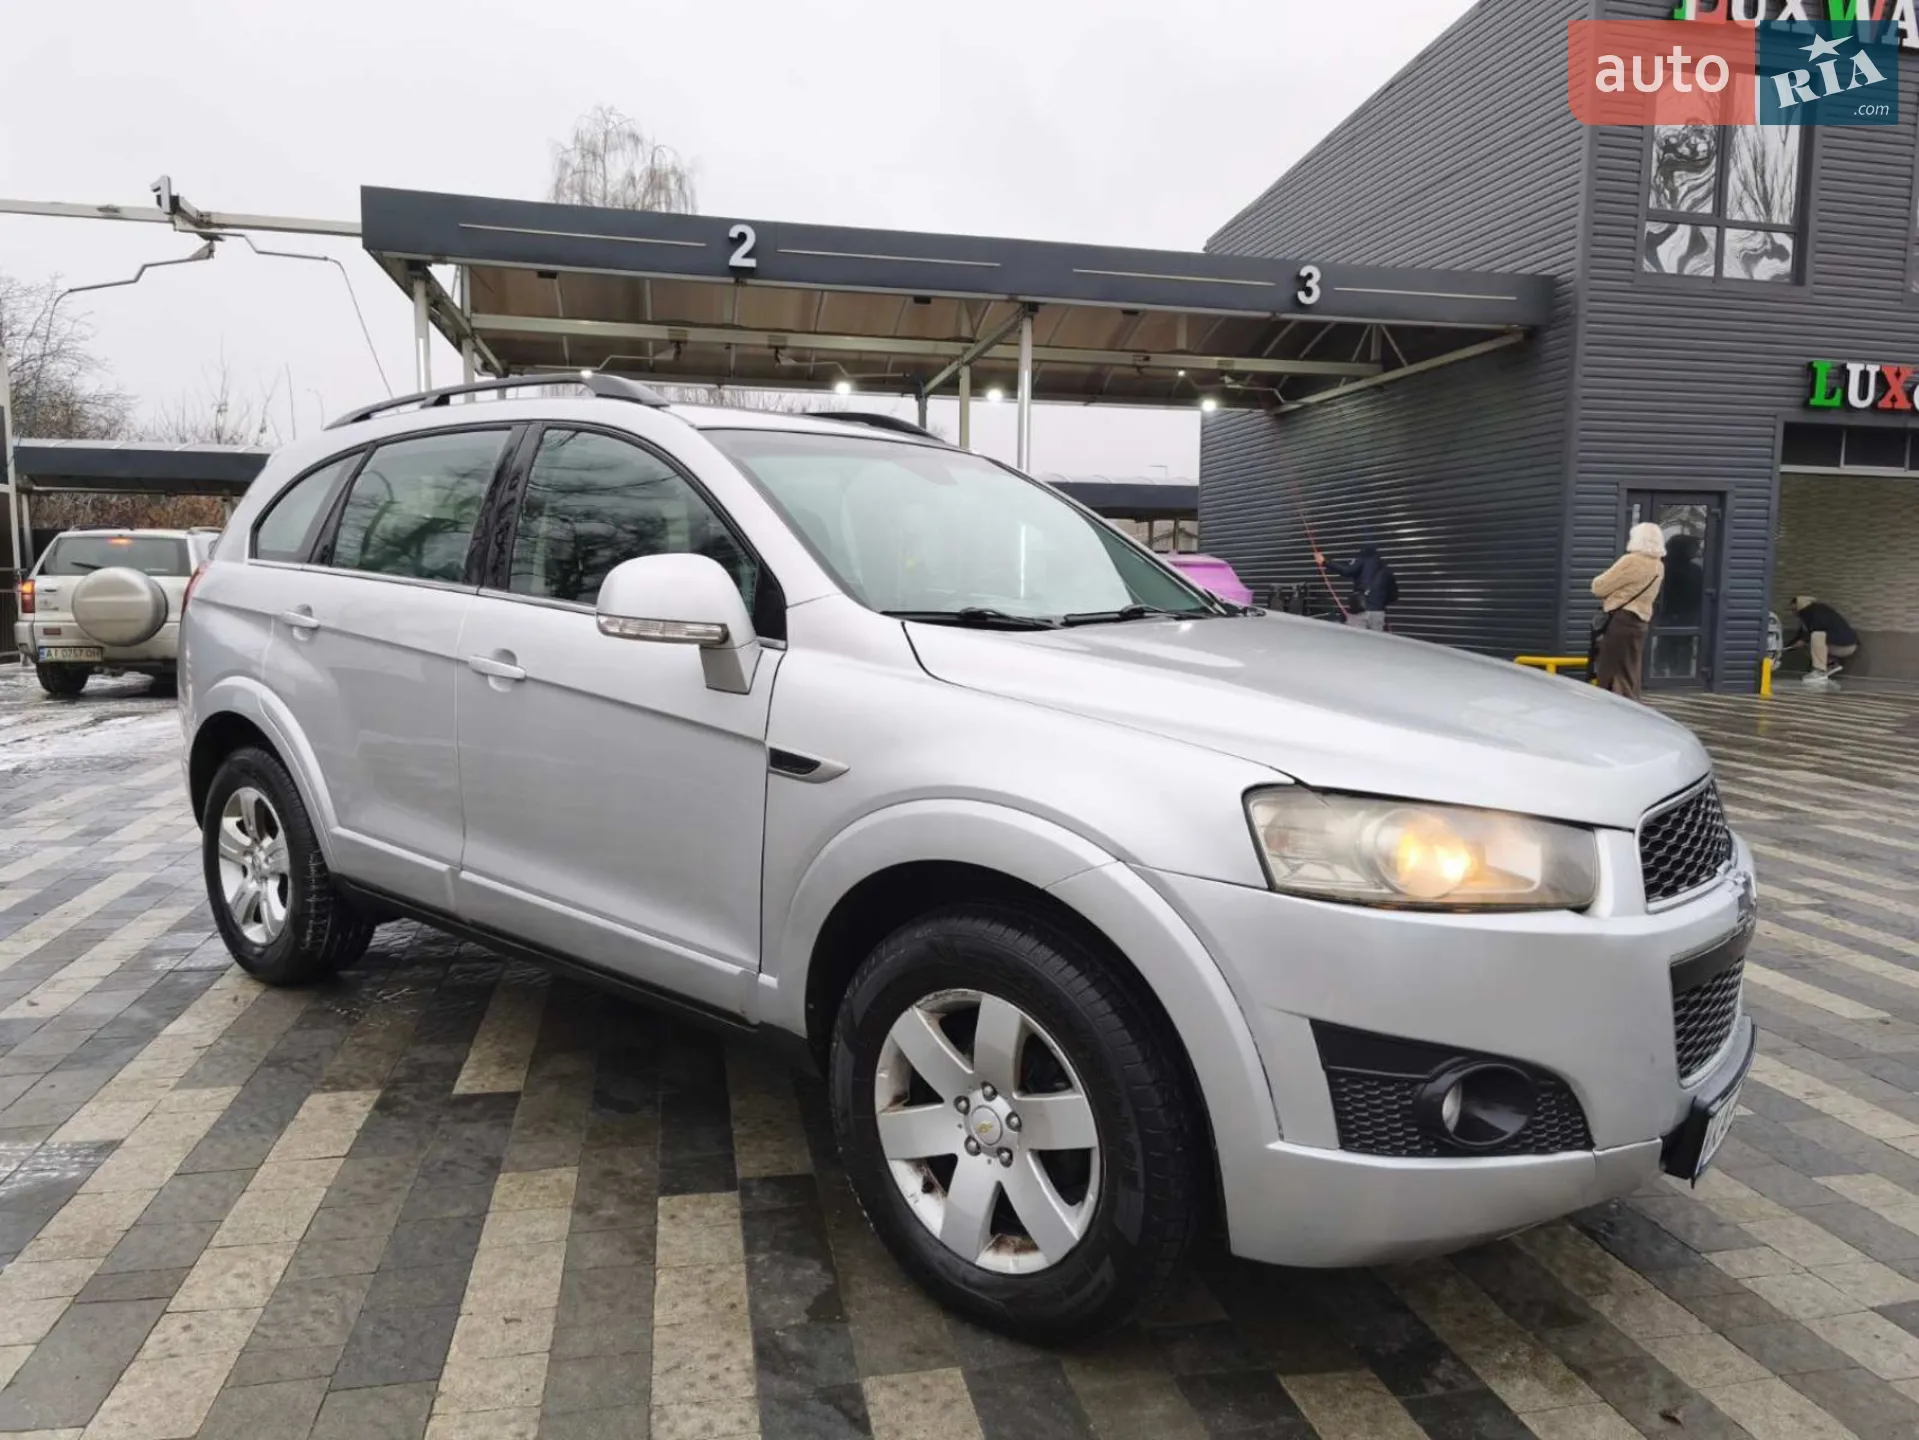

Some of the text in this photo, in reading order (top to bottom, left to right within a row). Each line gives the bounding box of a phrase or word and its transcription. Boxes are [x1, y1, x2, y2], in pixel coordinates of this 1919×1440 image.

[728, 223, 757, 268] 2
[1297, 265, 1321, 305] 3
[1808, 359, 1919, 413] LUX
